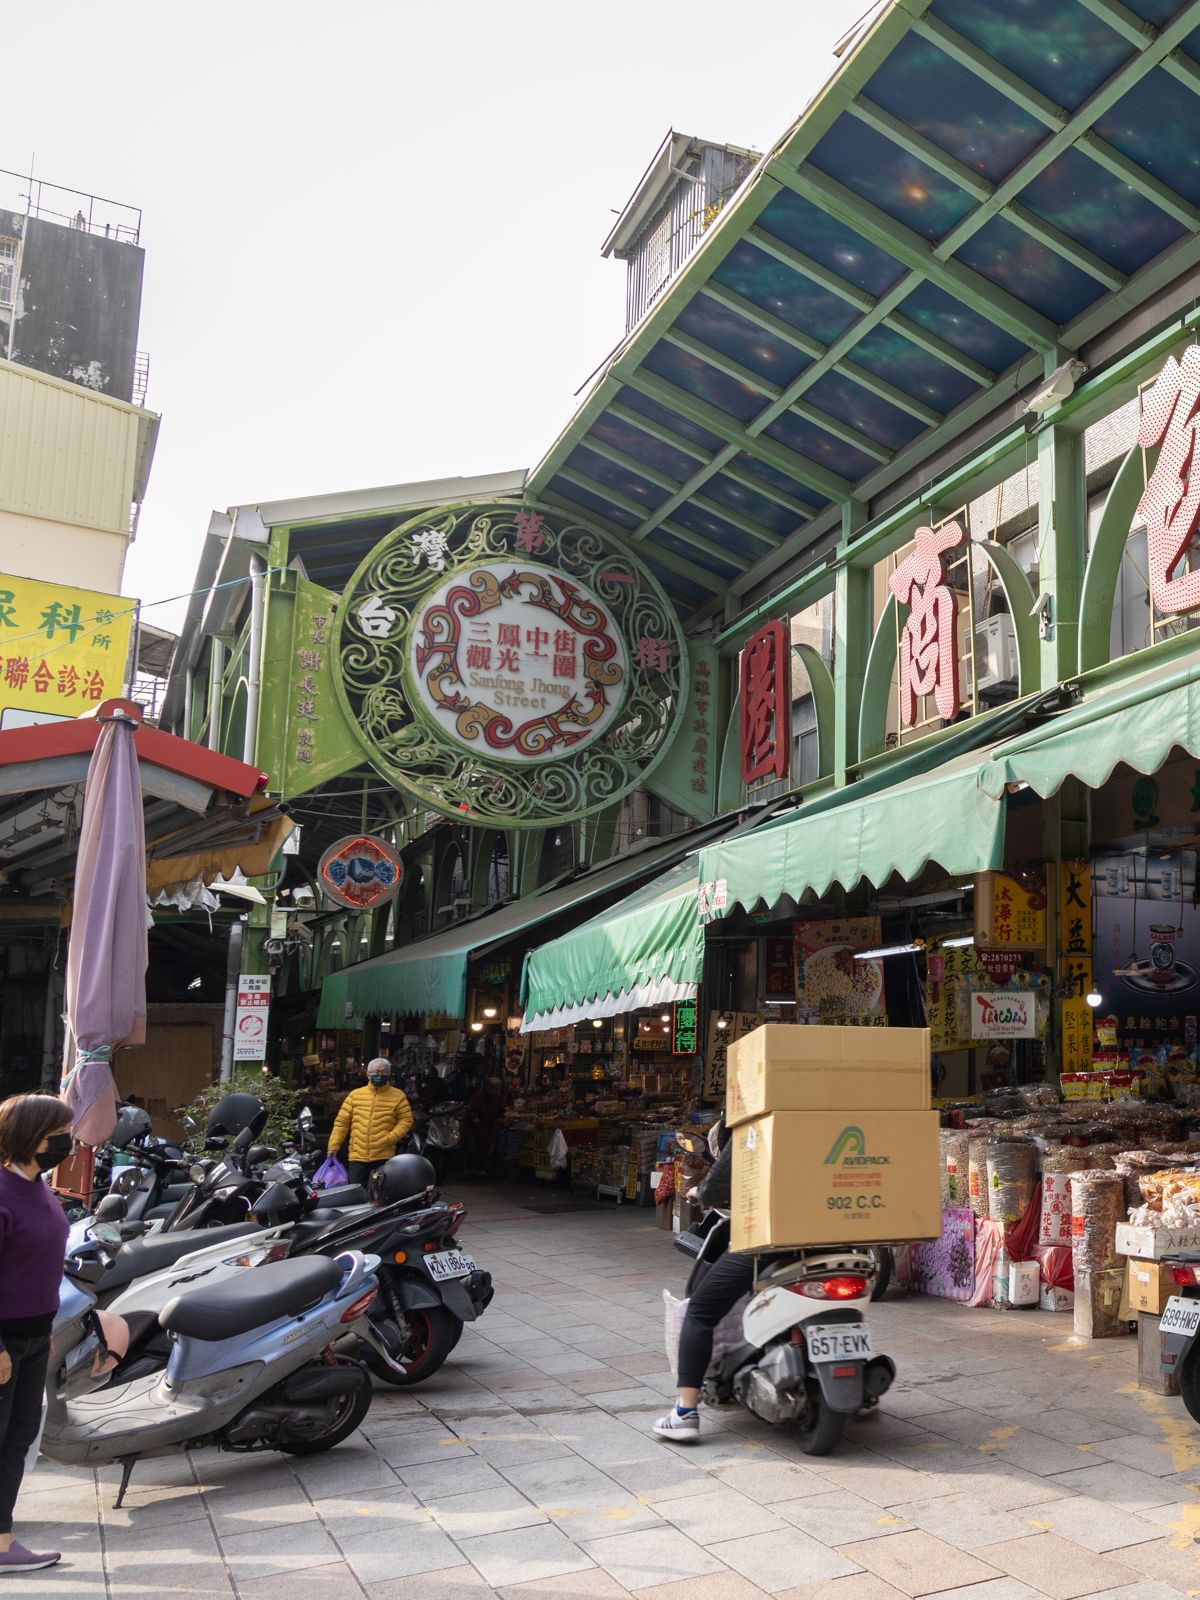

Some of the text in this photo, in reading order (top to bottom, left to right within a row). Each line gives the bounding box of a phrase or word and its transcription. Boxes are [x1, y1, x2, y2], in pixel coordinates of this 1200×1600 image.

[466, 620, 577, 655] 三鳳中街
[466, 645, 577, 679] 觀光圈
[0, 656, 105, 701] 聯合診治
[469, 671, 572, 699] Sanfong Jhong
[494, 693, 548, 710] Street
[1065, 873, 1089, 998] 大益行
[676, 999, 697, 1053] 優待
[827, 1194, 887, 1210] 902 C.C.
[1162, 1307, 1200, 1331] 689-HWB
[811, 1334, 871, 1356] 657-EVK
